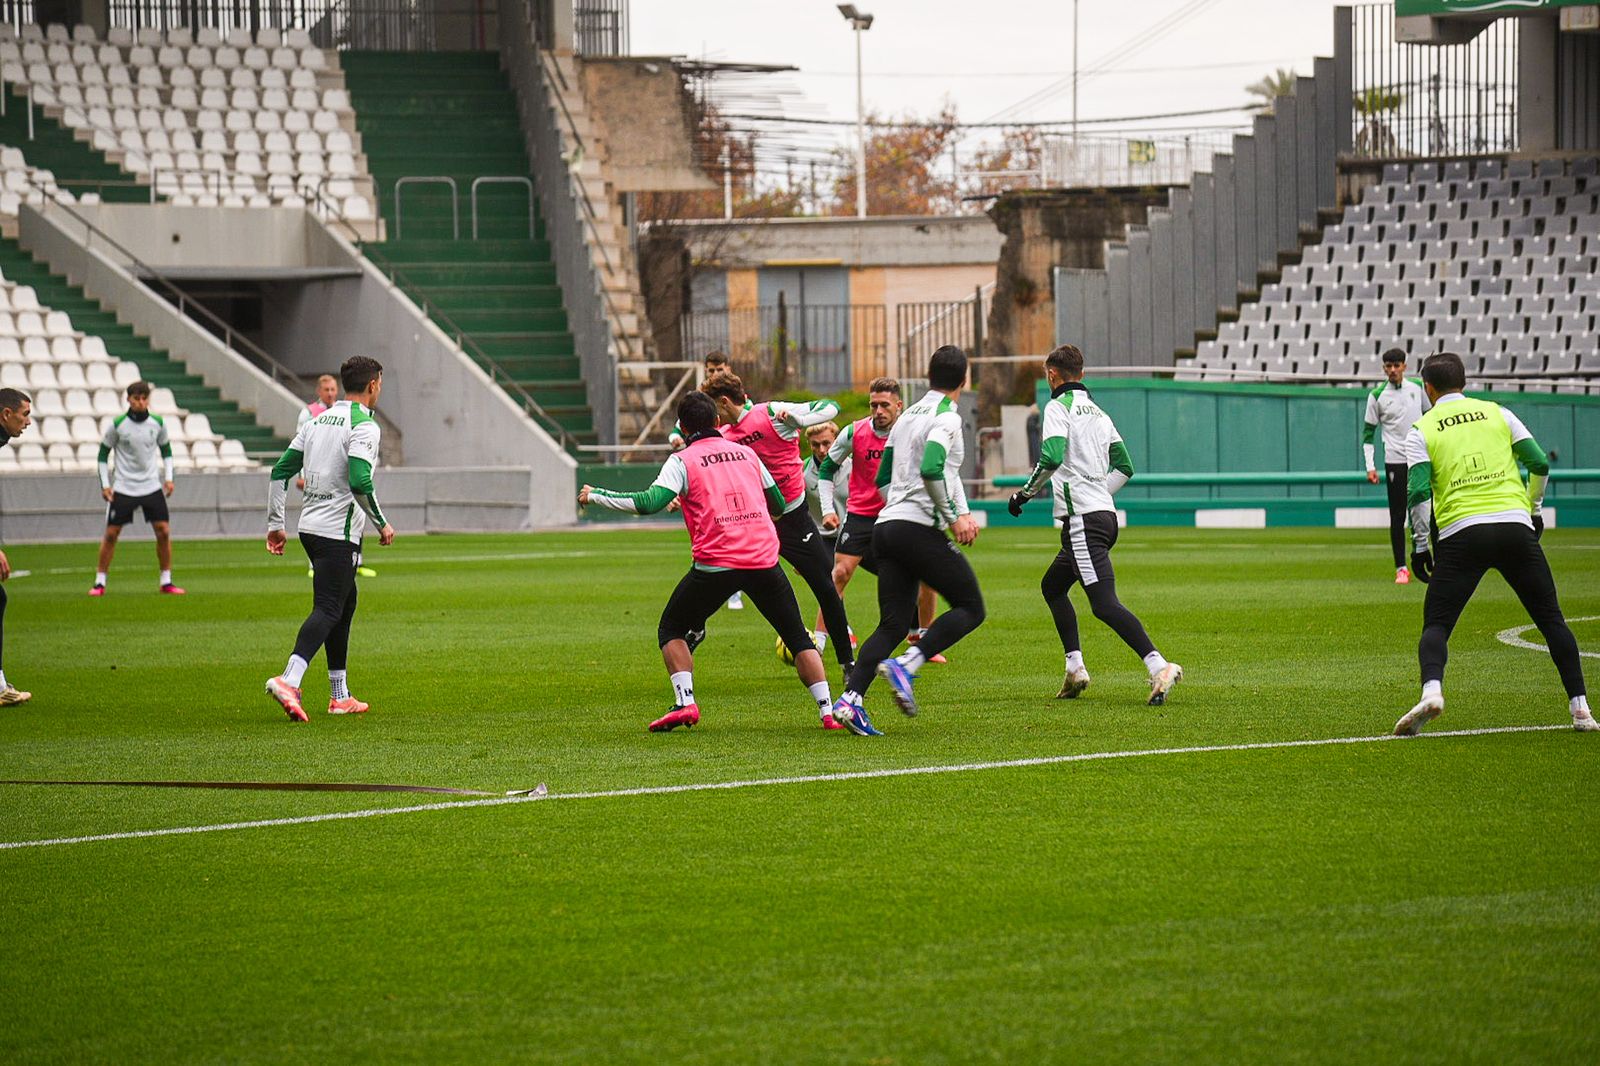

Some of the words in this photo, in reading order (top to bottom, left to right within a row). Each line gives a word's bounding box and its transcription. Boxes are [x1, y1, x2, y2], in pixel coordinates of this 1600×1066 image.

[1437, 411, 1488, 432] Joma
[700, 451, 747, 468] Joma
[865, 449, 883, 460] Jo
